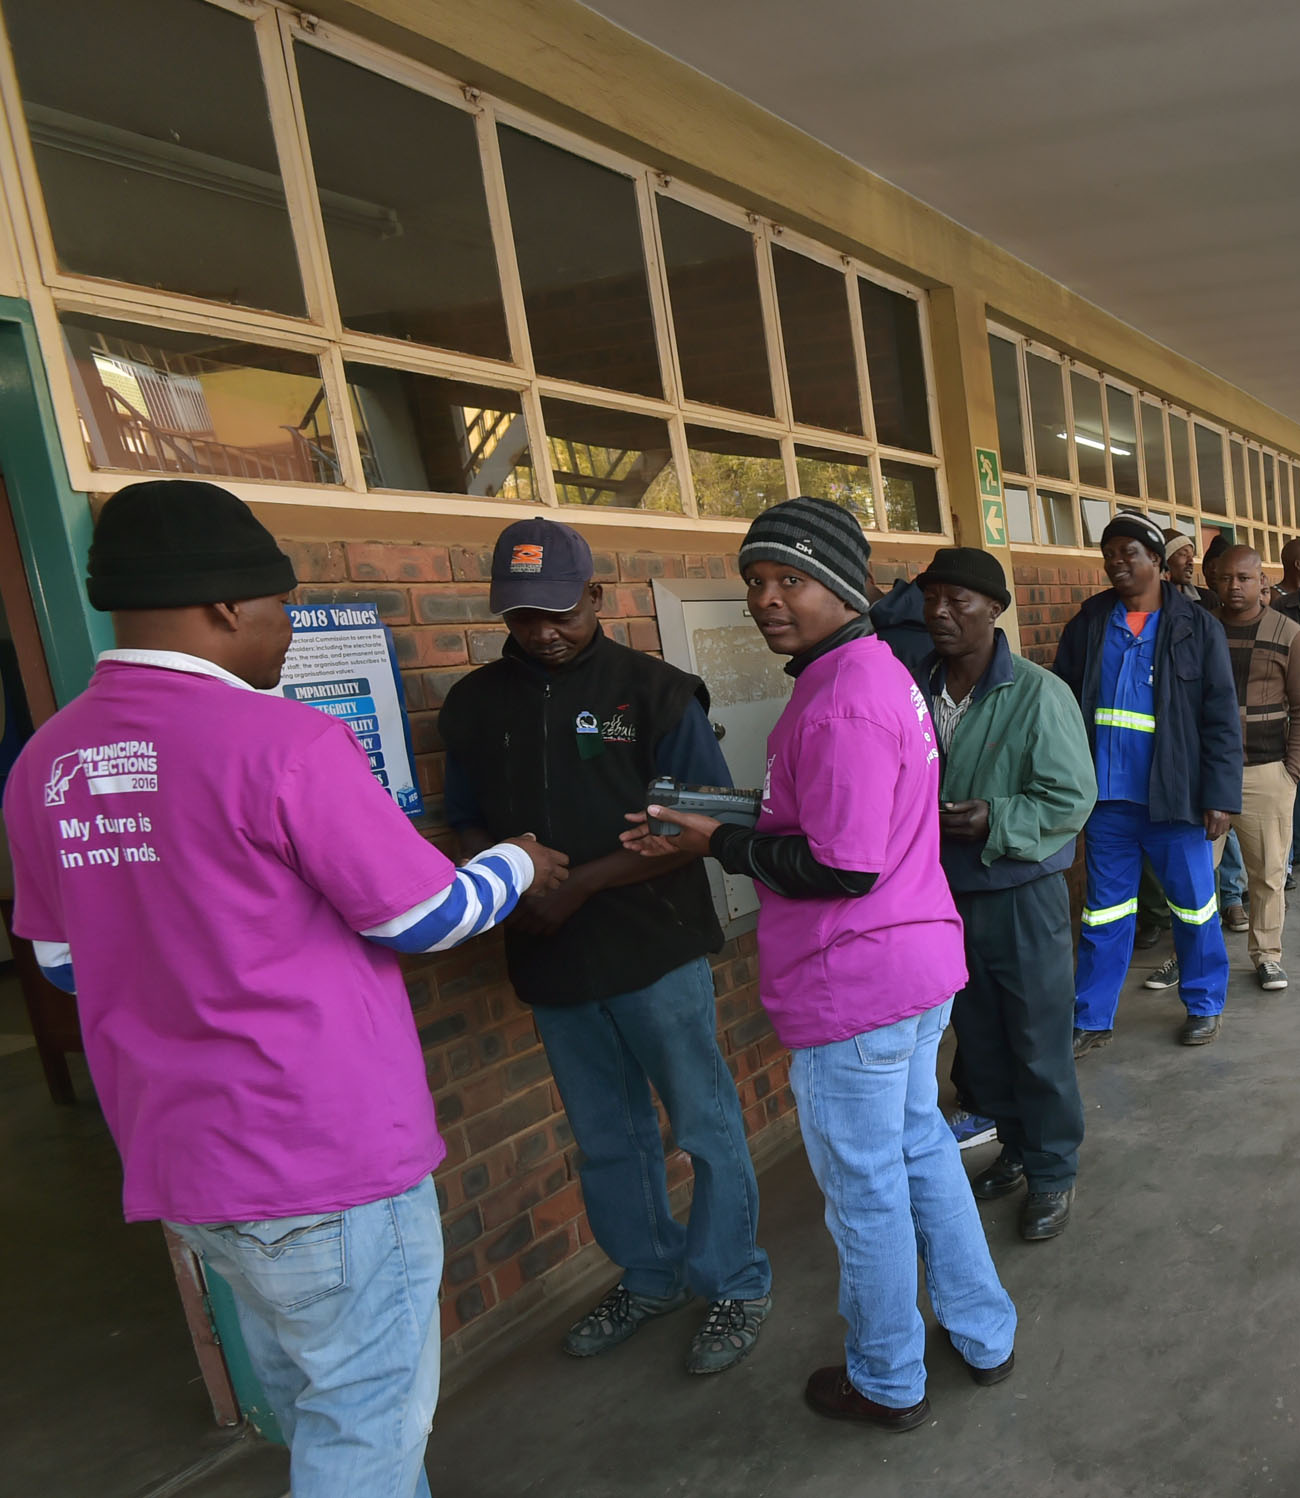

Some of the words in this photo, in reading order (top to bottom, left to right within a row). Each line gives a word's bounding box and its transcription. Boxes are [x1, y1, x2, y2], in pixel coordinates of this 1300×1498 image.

[290, 609, 328, 628] 2018
[330, 608, 377, 626] Values
[315, 635, 350, 643] Commission
[316, 643, 342, 651] including
[343, 650, 374, 659] permanent
[313, 659, 349, 669] organisation
[294, 669, 335, 679] organisational
[294, 682, 360, 699] IMPARTIALITY
[315, 701, 357, 715] TEGRITY
[79, 741, 158, 762] MUNICIPAL
[132, 778, 157, 790] 2016
[59, 818, 91, 842] My
[138, 812, 153, 833] is
[60, 849, 84, 869] in
[87, 846, 119, 868] my
[123, 842, 161, 863] nds.
